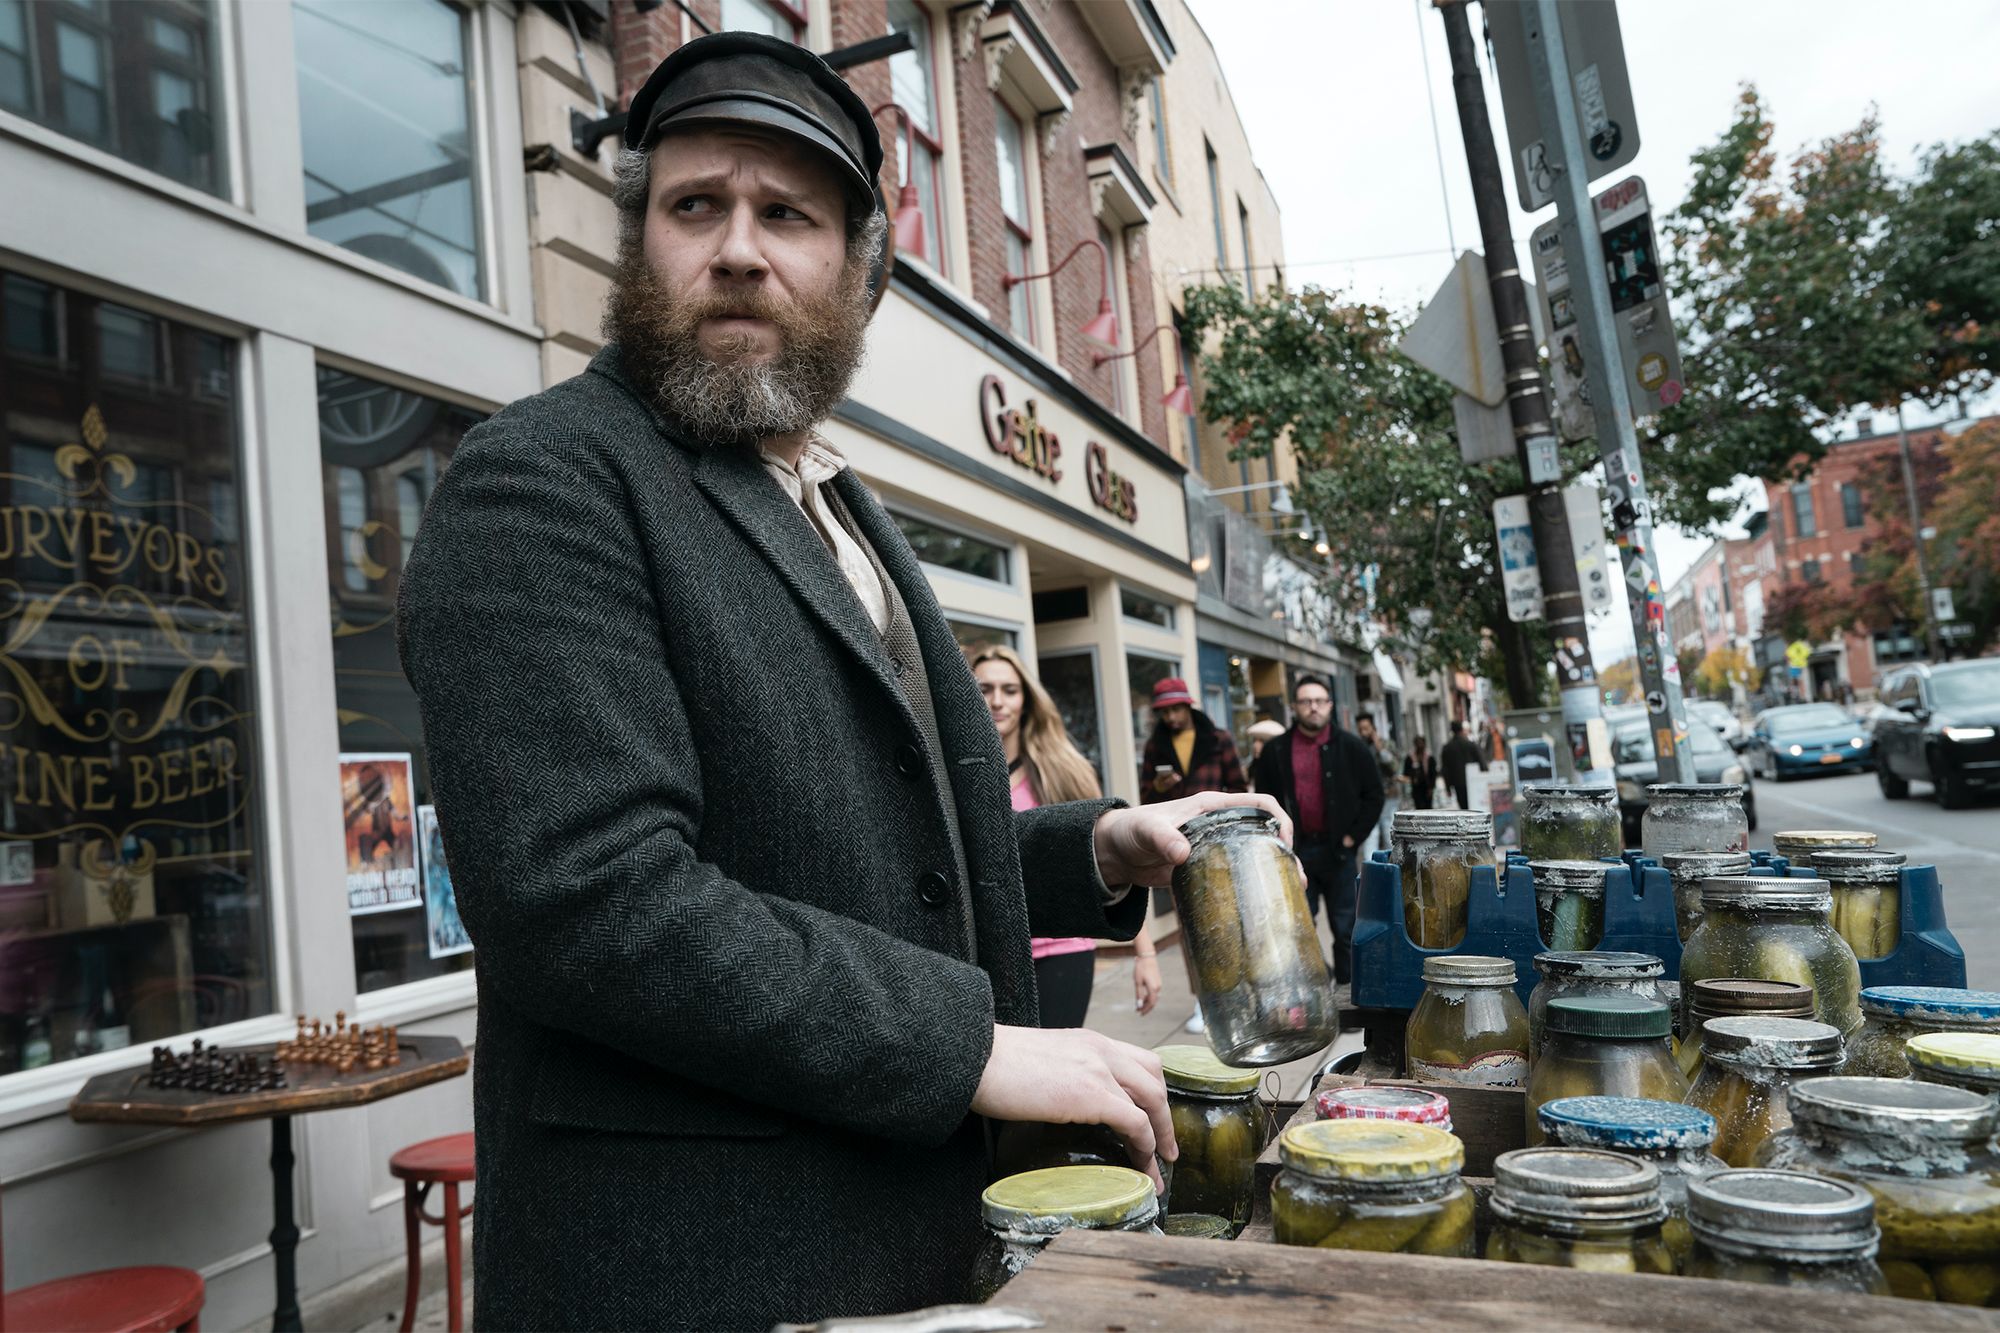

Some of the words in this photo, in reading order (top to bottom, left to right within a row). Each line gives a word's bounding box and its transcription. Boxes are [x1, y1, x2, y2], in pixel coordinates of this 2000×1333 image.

[67, 634, 143, 692] OF
[0, 742, 117, 812] INE
[129, 737, 244, 810] BEER
